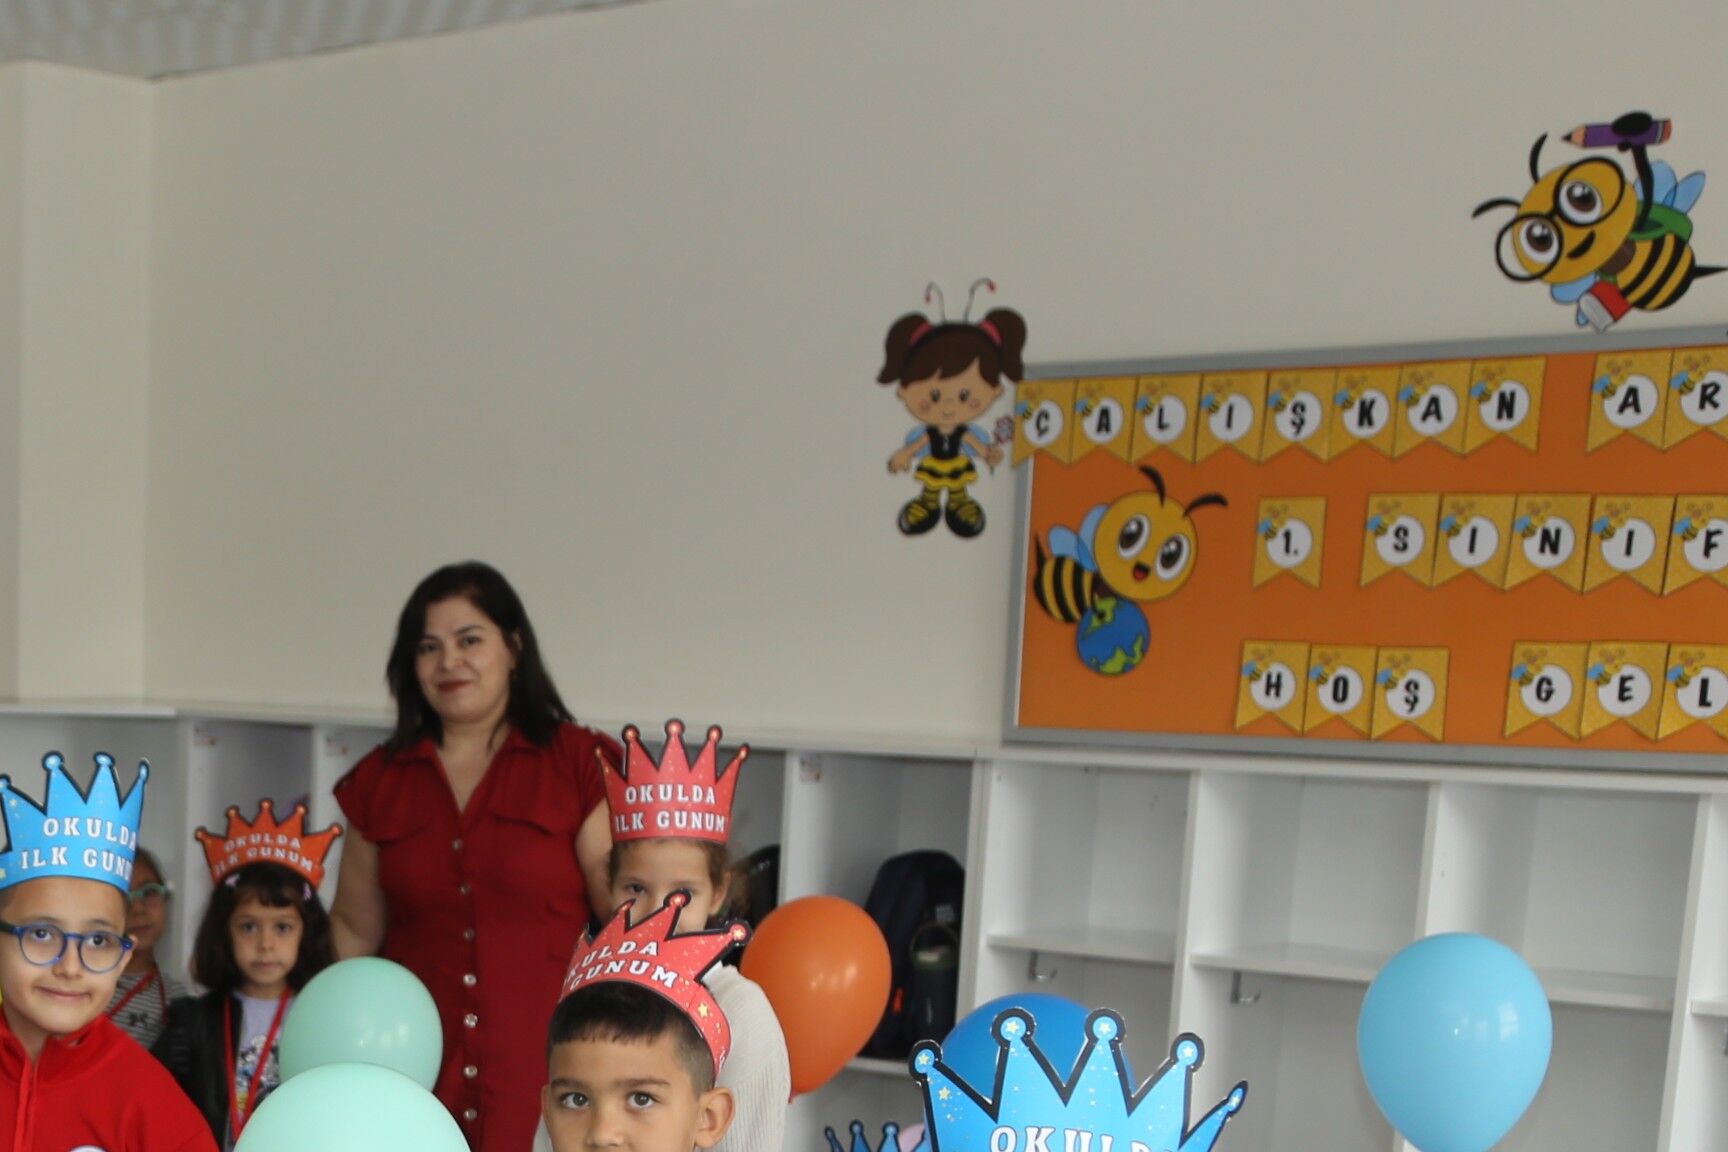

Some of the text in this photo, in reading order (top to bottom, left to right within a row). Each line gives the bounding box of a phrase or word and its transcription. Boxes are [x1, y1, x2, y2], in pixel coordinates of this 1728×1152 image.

[1035, 379, 1518, 440] ÇALIŞKAN
[1392, 526, 1721, 558] SINIF
[1263, 674, 1420, 714] HOŞ
[625, 783, 716, 805] OKULDA
[224, 833, 301, 853] OKULDA
